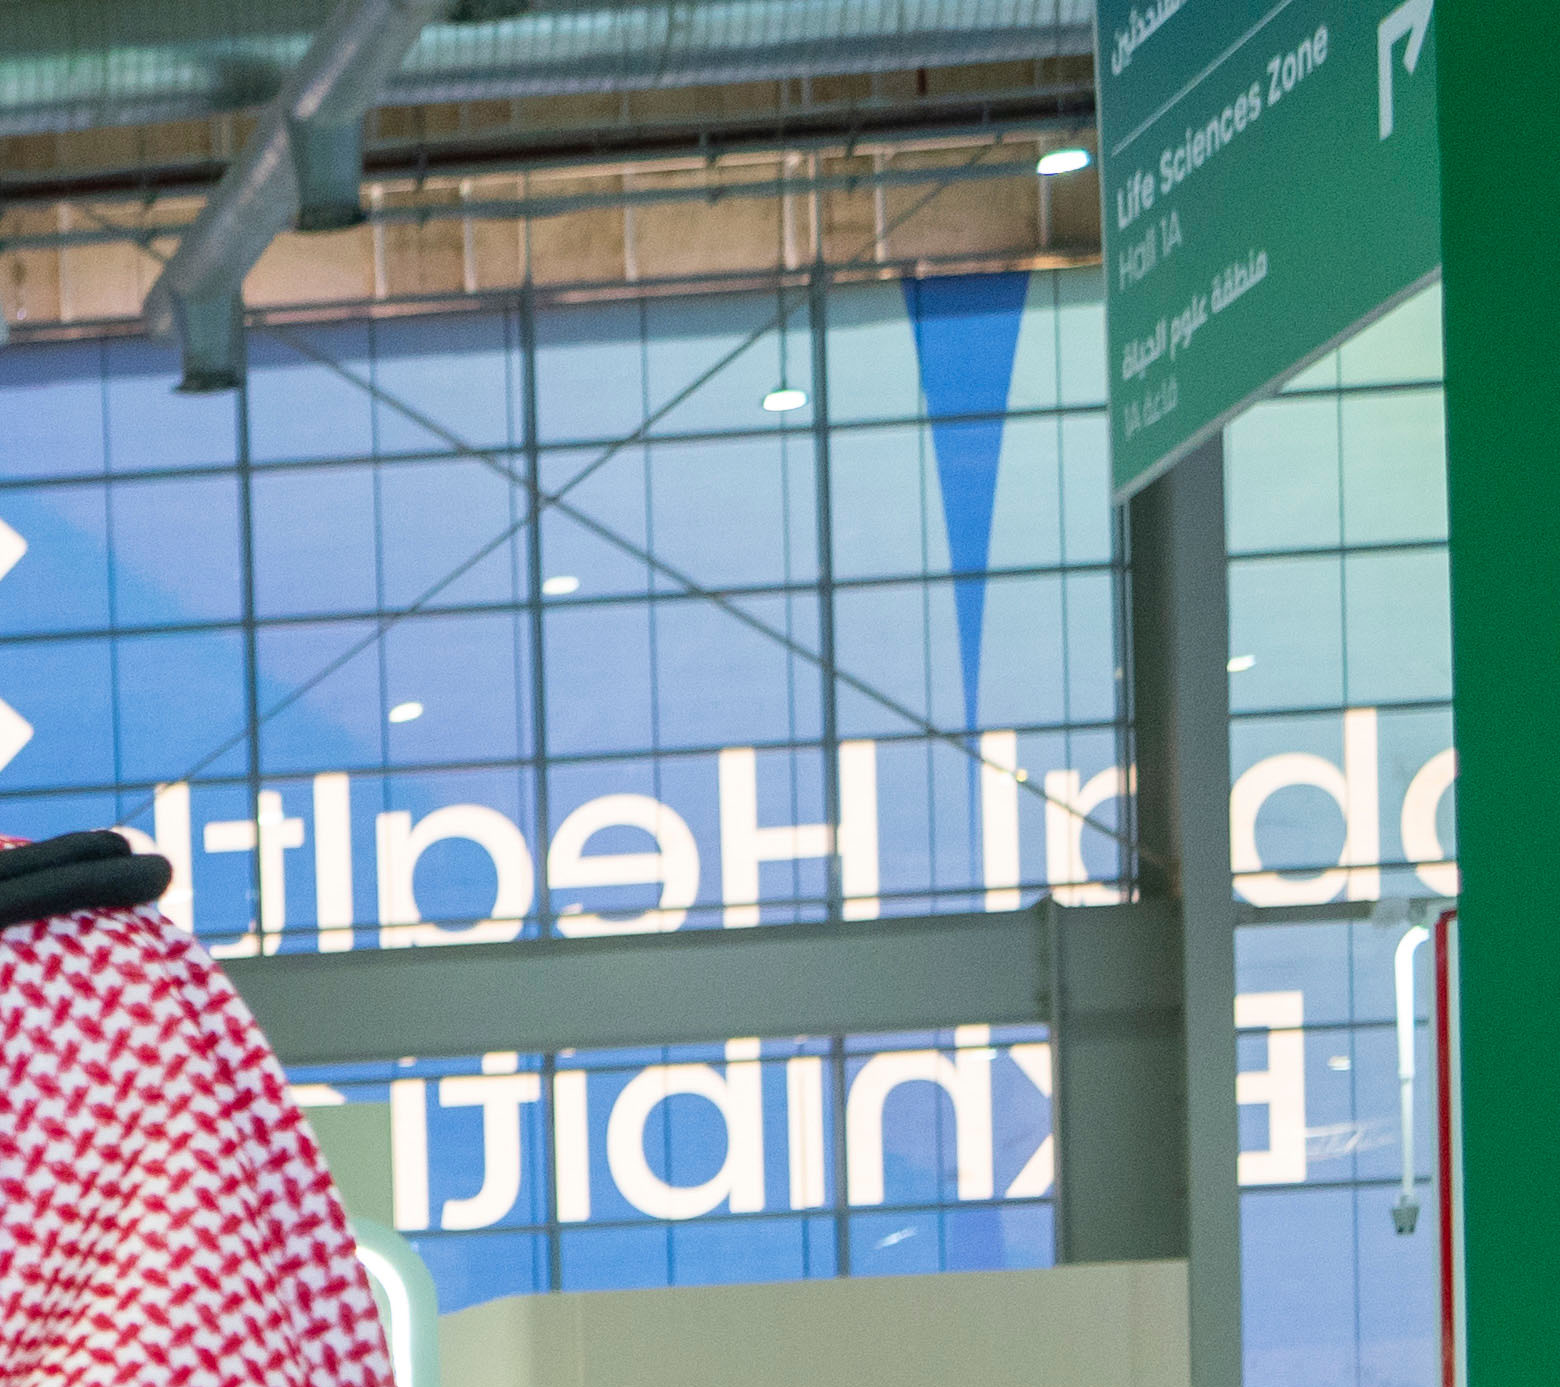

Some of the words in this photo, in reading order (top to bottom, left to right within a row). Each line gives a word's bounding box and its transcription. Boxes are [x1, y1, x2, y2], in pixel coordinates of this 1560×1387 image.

[1117, 170, 1155, 230] Life
[1159, 82, 1262, 196] Sciences
[1266, 24, 1329, 107] Zone
[1120, 224, 1157, 291] Hall
